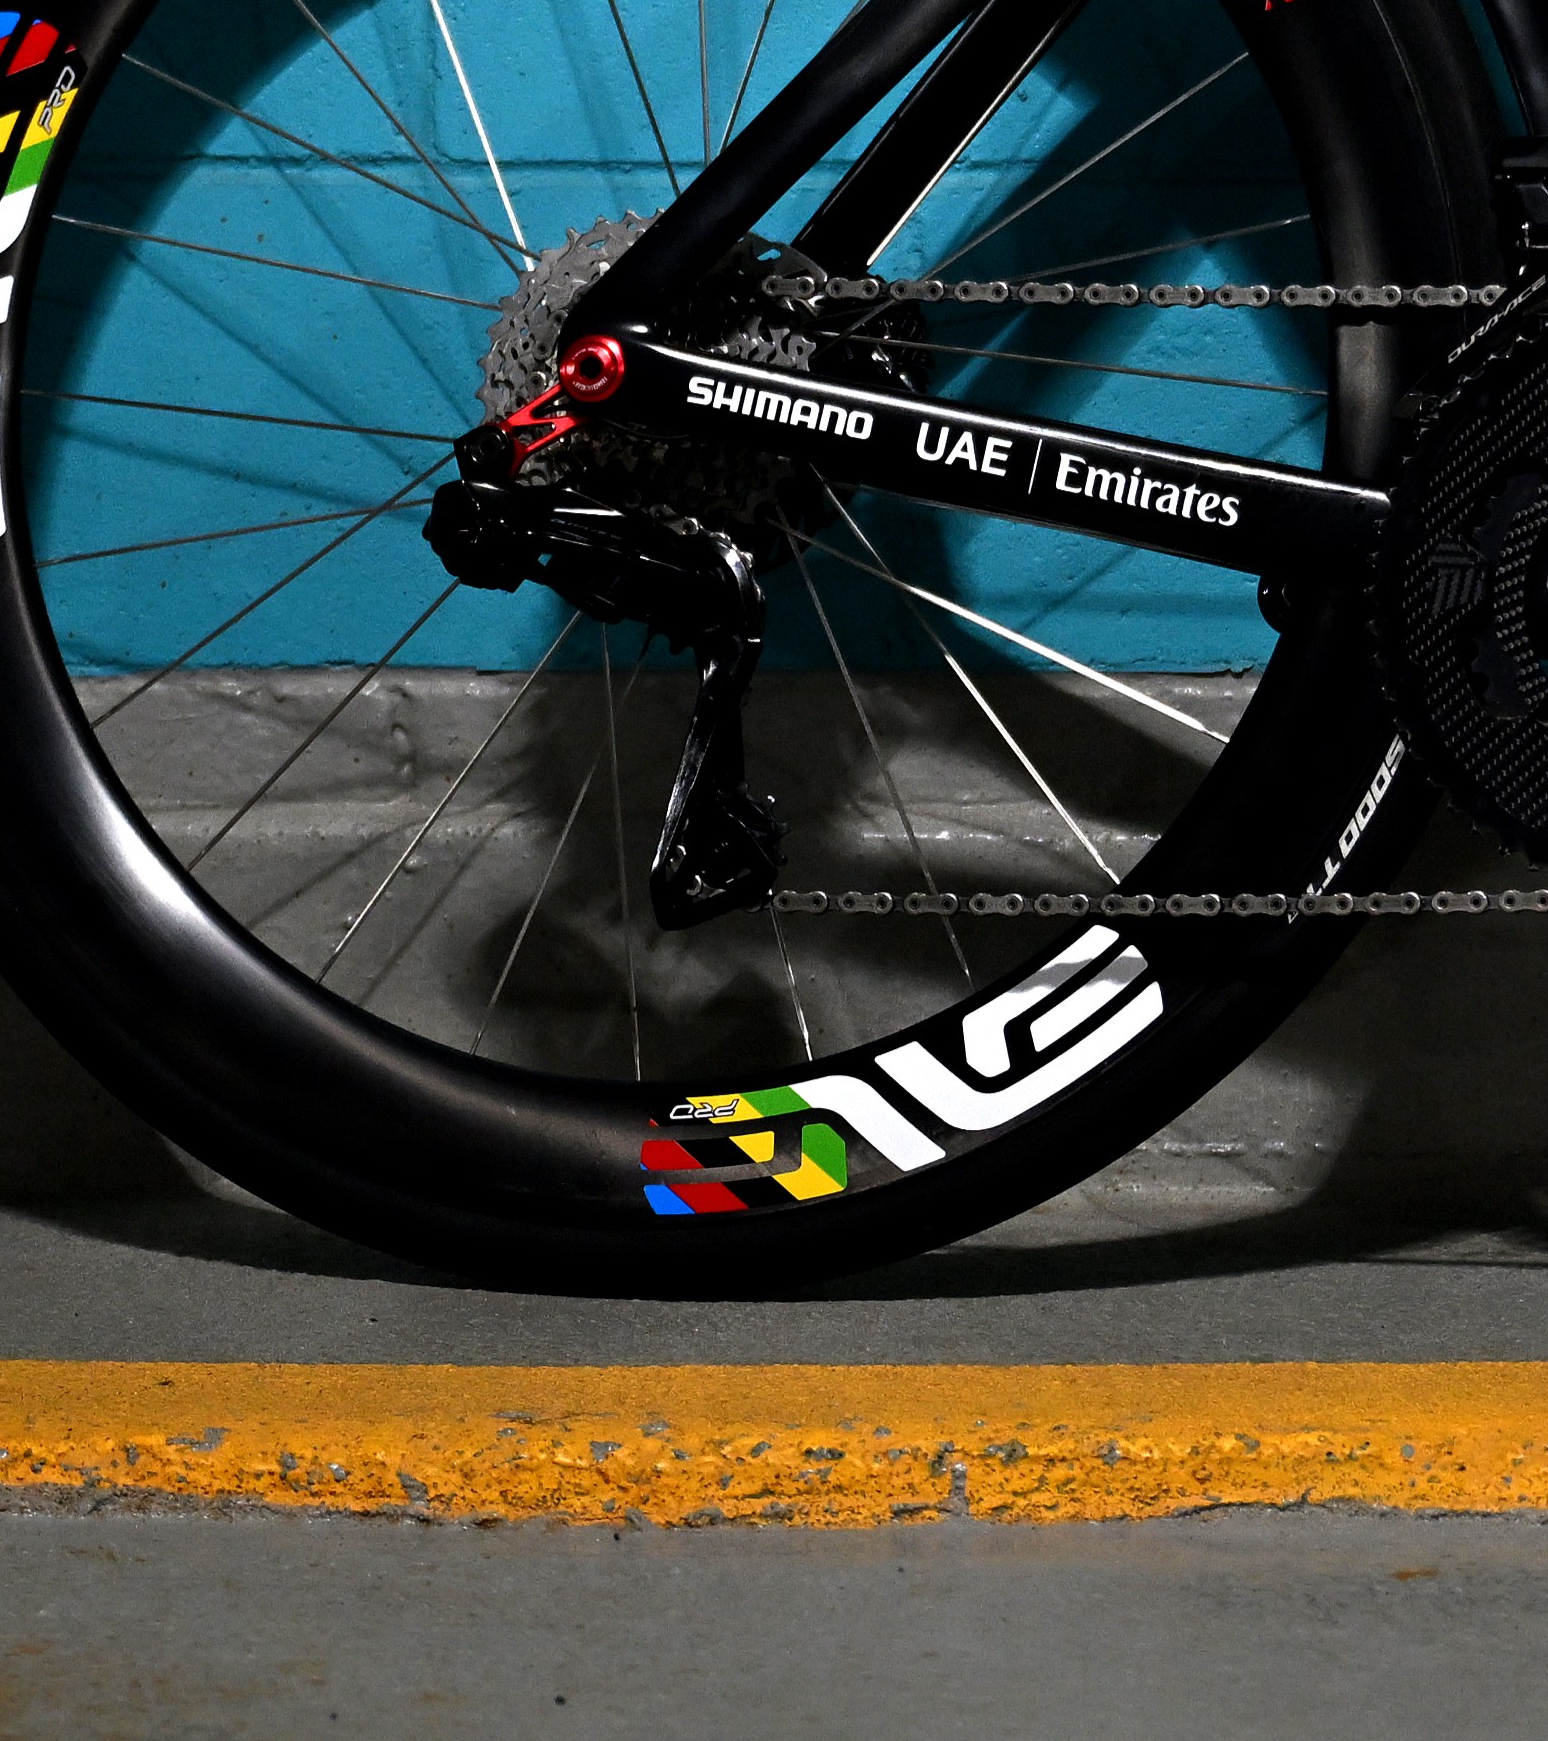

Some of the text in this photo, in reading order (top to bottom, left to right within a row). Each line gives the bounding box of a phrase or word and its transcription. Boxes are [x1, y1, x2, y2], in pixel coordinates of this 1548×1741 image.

[38, 66, 76, 133] PRO
[1448, 275, 1547, 364] DURA-ACE
[687, 377, 874, 440] SHIMANO
[916, 421, 1241, 527] UAE Emirates
[671, 1096, 739, 1120] PRO
